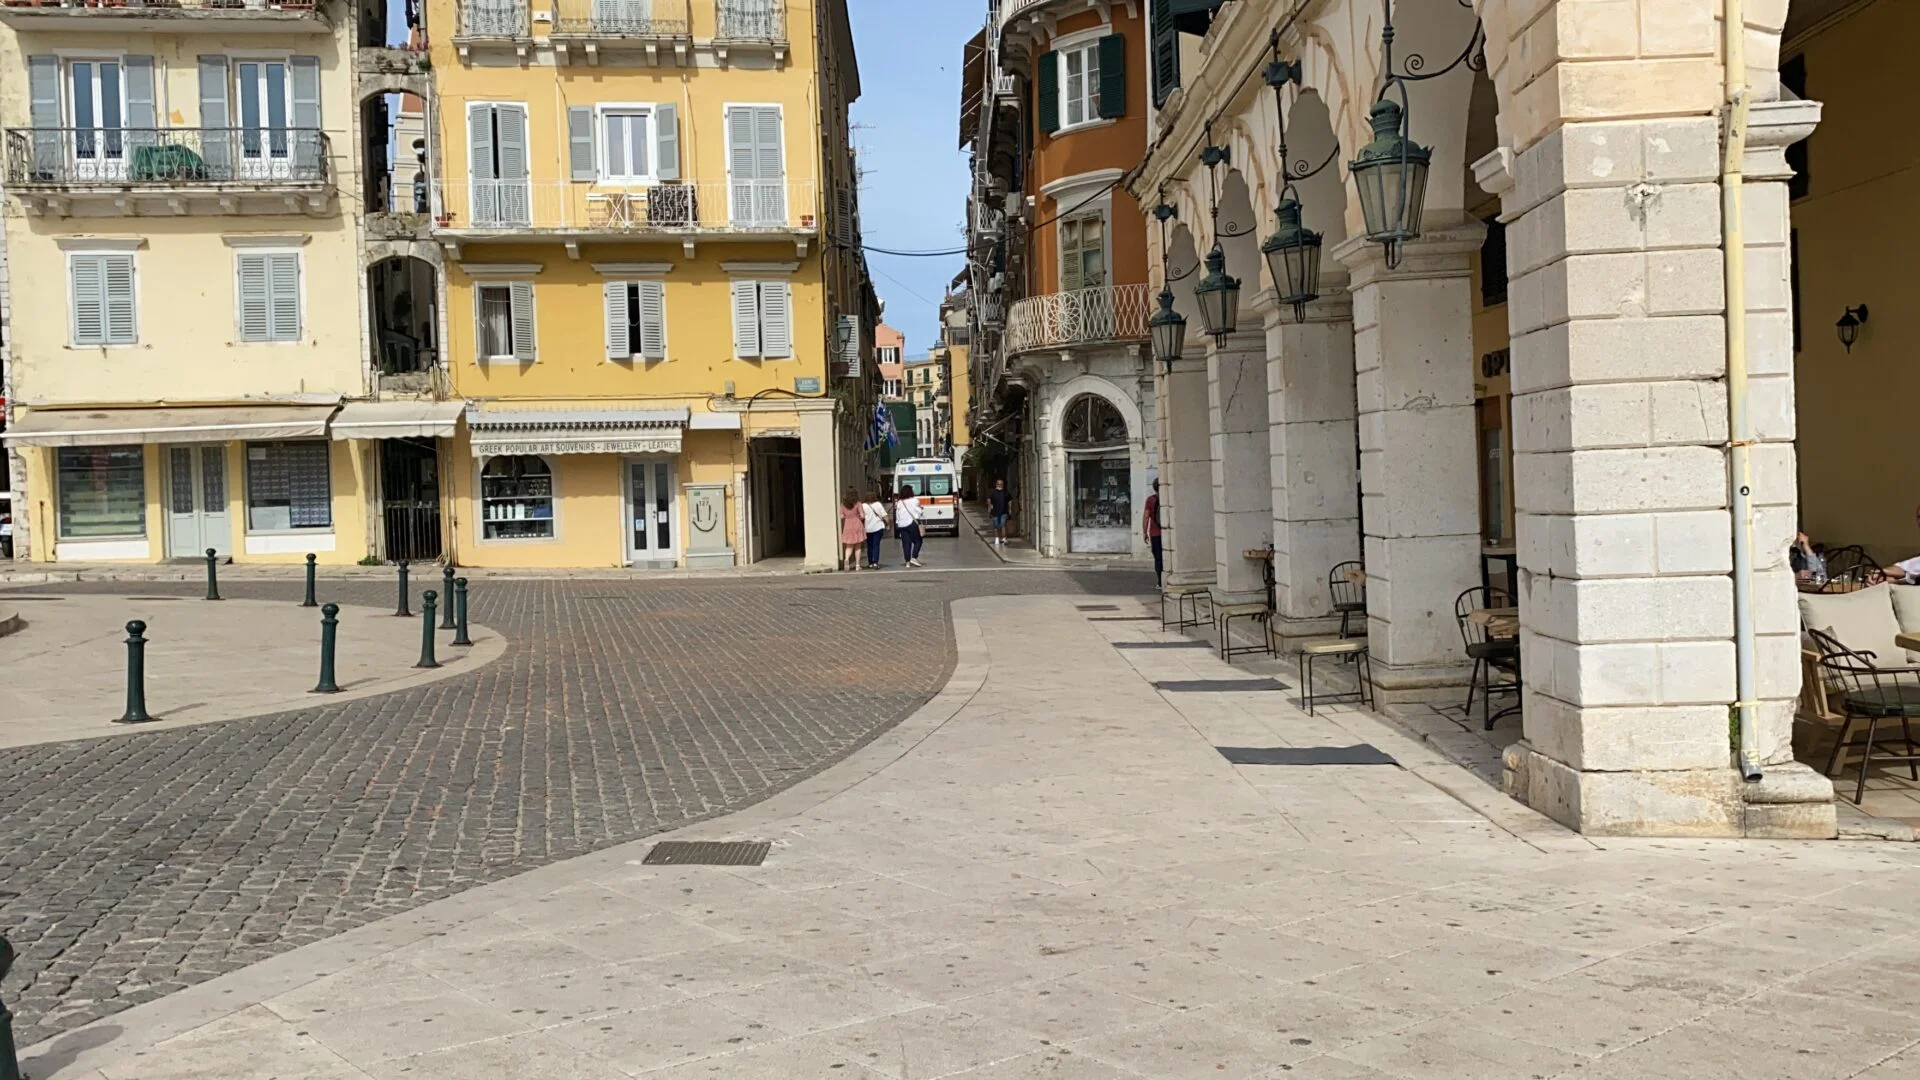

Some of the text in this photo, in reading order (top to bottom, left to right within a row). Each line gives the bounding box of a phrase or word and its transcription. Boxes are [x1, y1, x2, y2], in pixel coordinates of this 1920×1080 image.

[479, 445, 502, 454] GREEK
[506, 444, 538, 453] POPULAR
[541, 444, 553, 452] ART
[556, 442, 595, 452] SOUVENIRS
[603, 441, 641, 451] JEWELLERY
